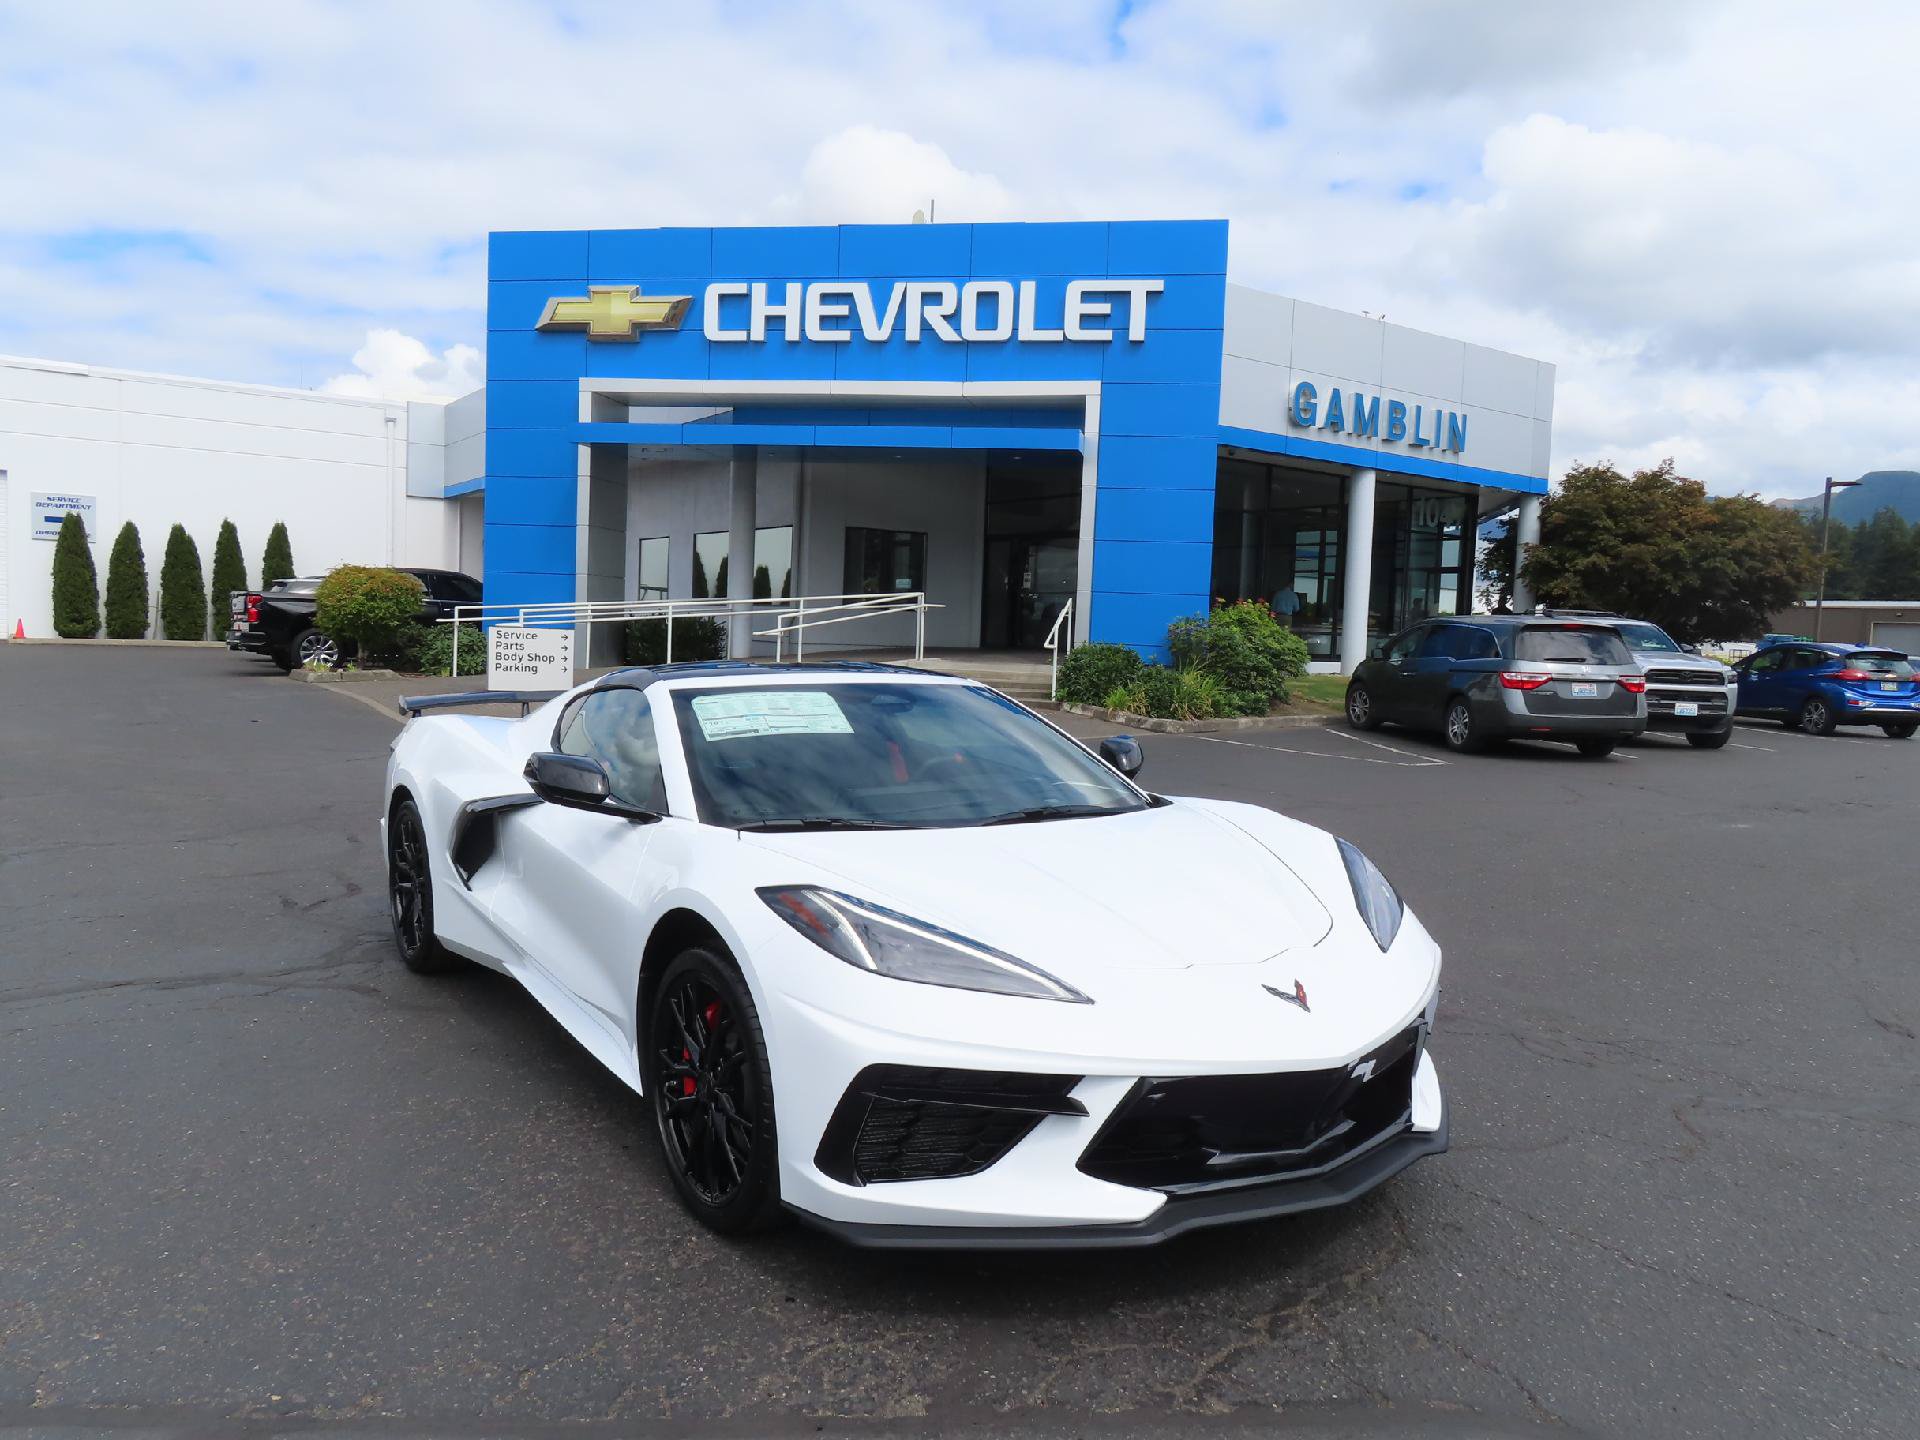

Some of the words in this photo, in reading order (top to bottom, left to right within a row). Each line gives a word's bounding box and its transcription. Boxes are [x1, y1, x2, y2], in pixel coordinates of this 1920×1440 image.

[703, 280, 1165, 343] CHEVROLET
[1290, 381, 1468, 453] GAMBLIN
[35, 502, 92, 510] DEPARTMENT
[496, 630, 538, 640] Service
[495, 641, 525, 650] Parts
[495, 652, 524, 663] Body
[527, 653, 555, 664] Shop
[495, 663, 538, 675] Parking
